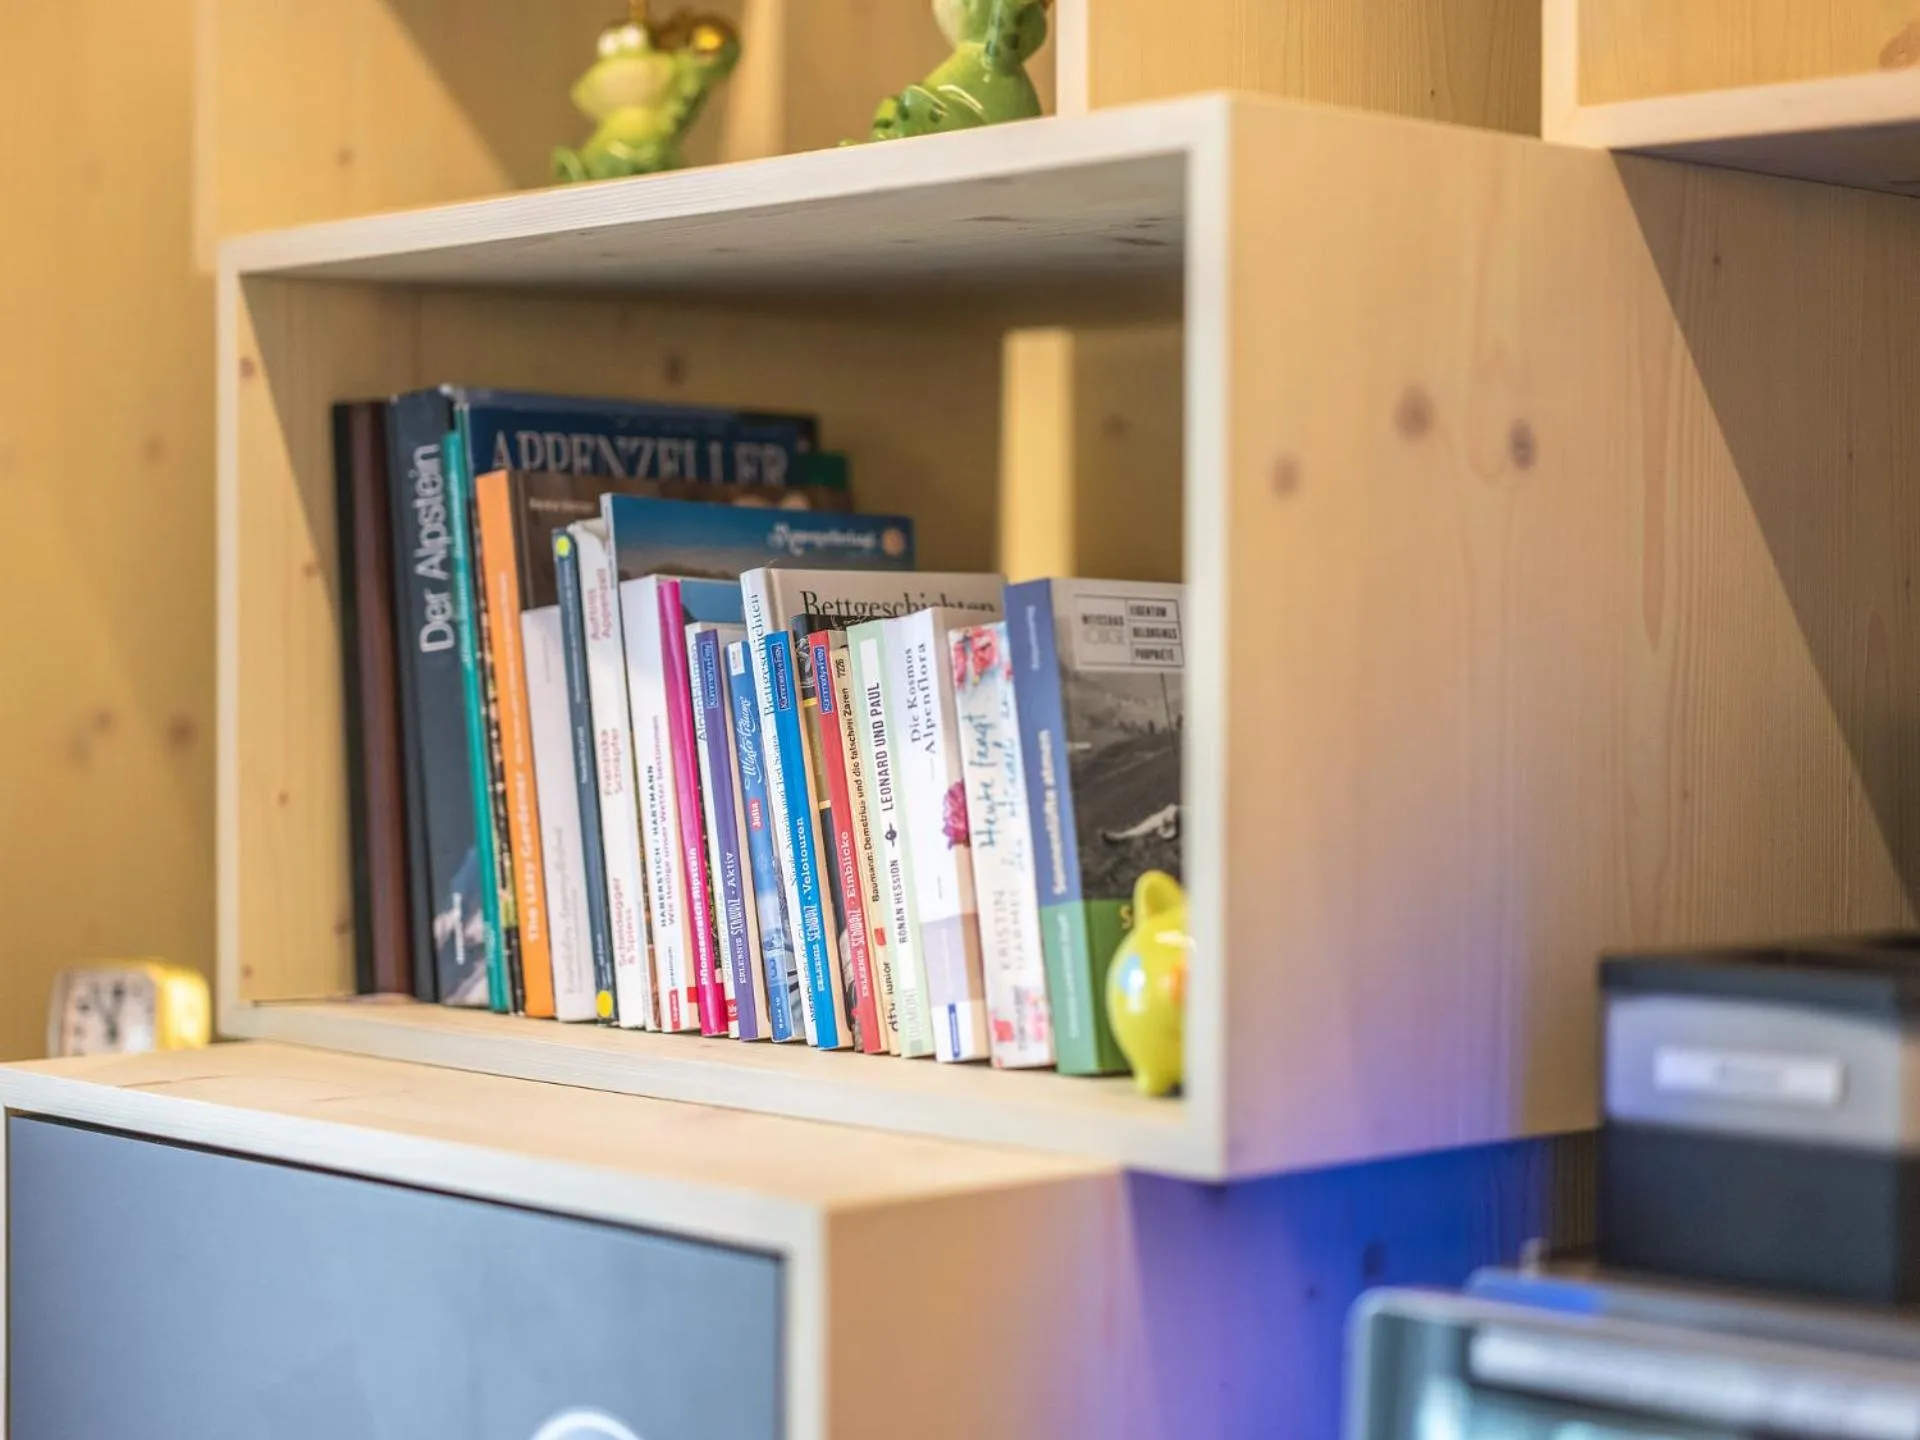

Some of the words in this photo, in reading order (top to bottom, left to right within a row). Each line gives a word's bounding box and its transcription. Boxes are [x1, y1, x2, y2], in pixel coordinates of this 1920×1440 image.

[407, 443, 451, 581] Alpstein
[419, 588, 455, 652] Der
[842, 687, 851, 715] Zaren
[867, 682, 882, 717] PAUL
[905, 648, 918, 711] Kosmos
[918, 643, 937, 754] Alpenflora
[652, 715, 662, 779] bestimmen
[872, 719, 886, 750] UND
[910, 714, 921, 743] Die
[850, 761, 861, 777] die
[853, 778, 864, 797] und
[875, 752, 894, 812] LEONARD
[649, 765, 658, 834] HARTMANN
[657, 784, 666, 822] Wetter
[725, 851, 736, 887] Aktiv
[796, 817, 813, 893] Velotouren
[840, 831, 856, 897] Einblicke
[523, 860, 538, 903] Lazy
[656, 847, 665, 927] HABERSTICH
[891, 859, 903, 903] HESSION
[526, 907, 540, 941] The
[613, 877, 627, 966] Scheidegger
[896, 907, 908, 943] RONAN
